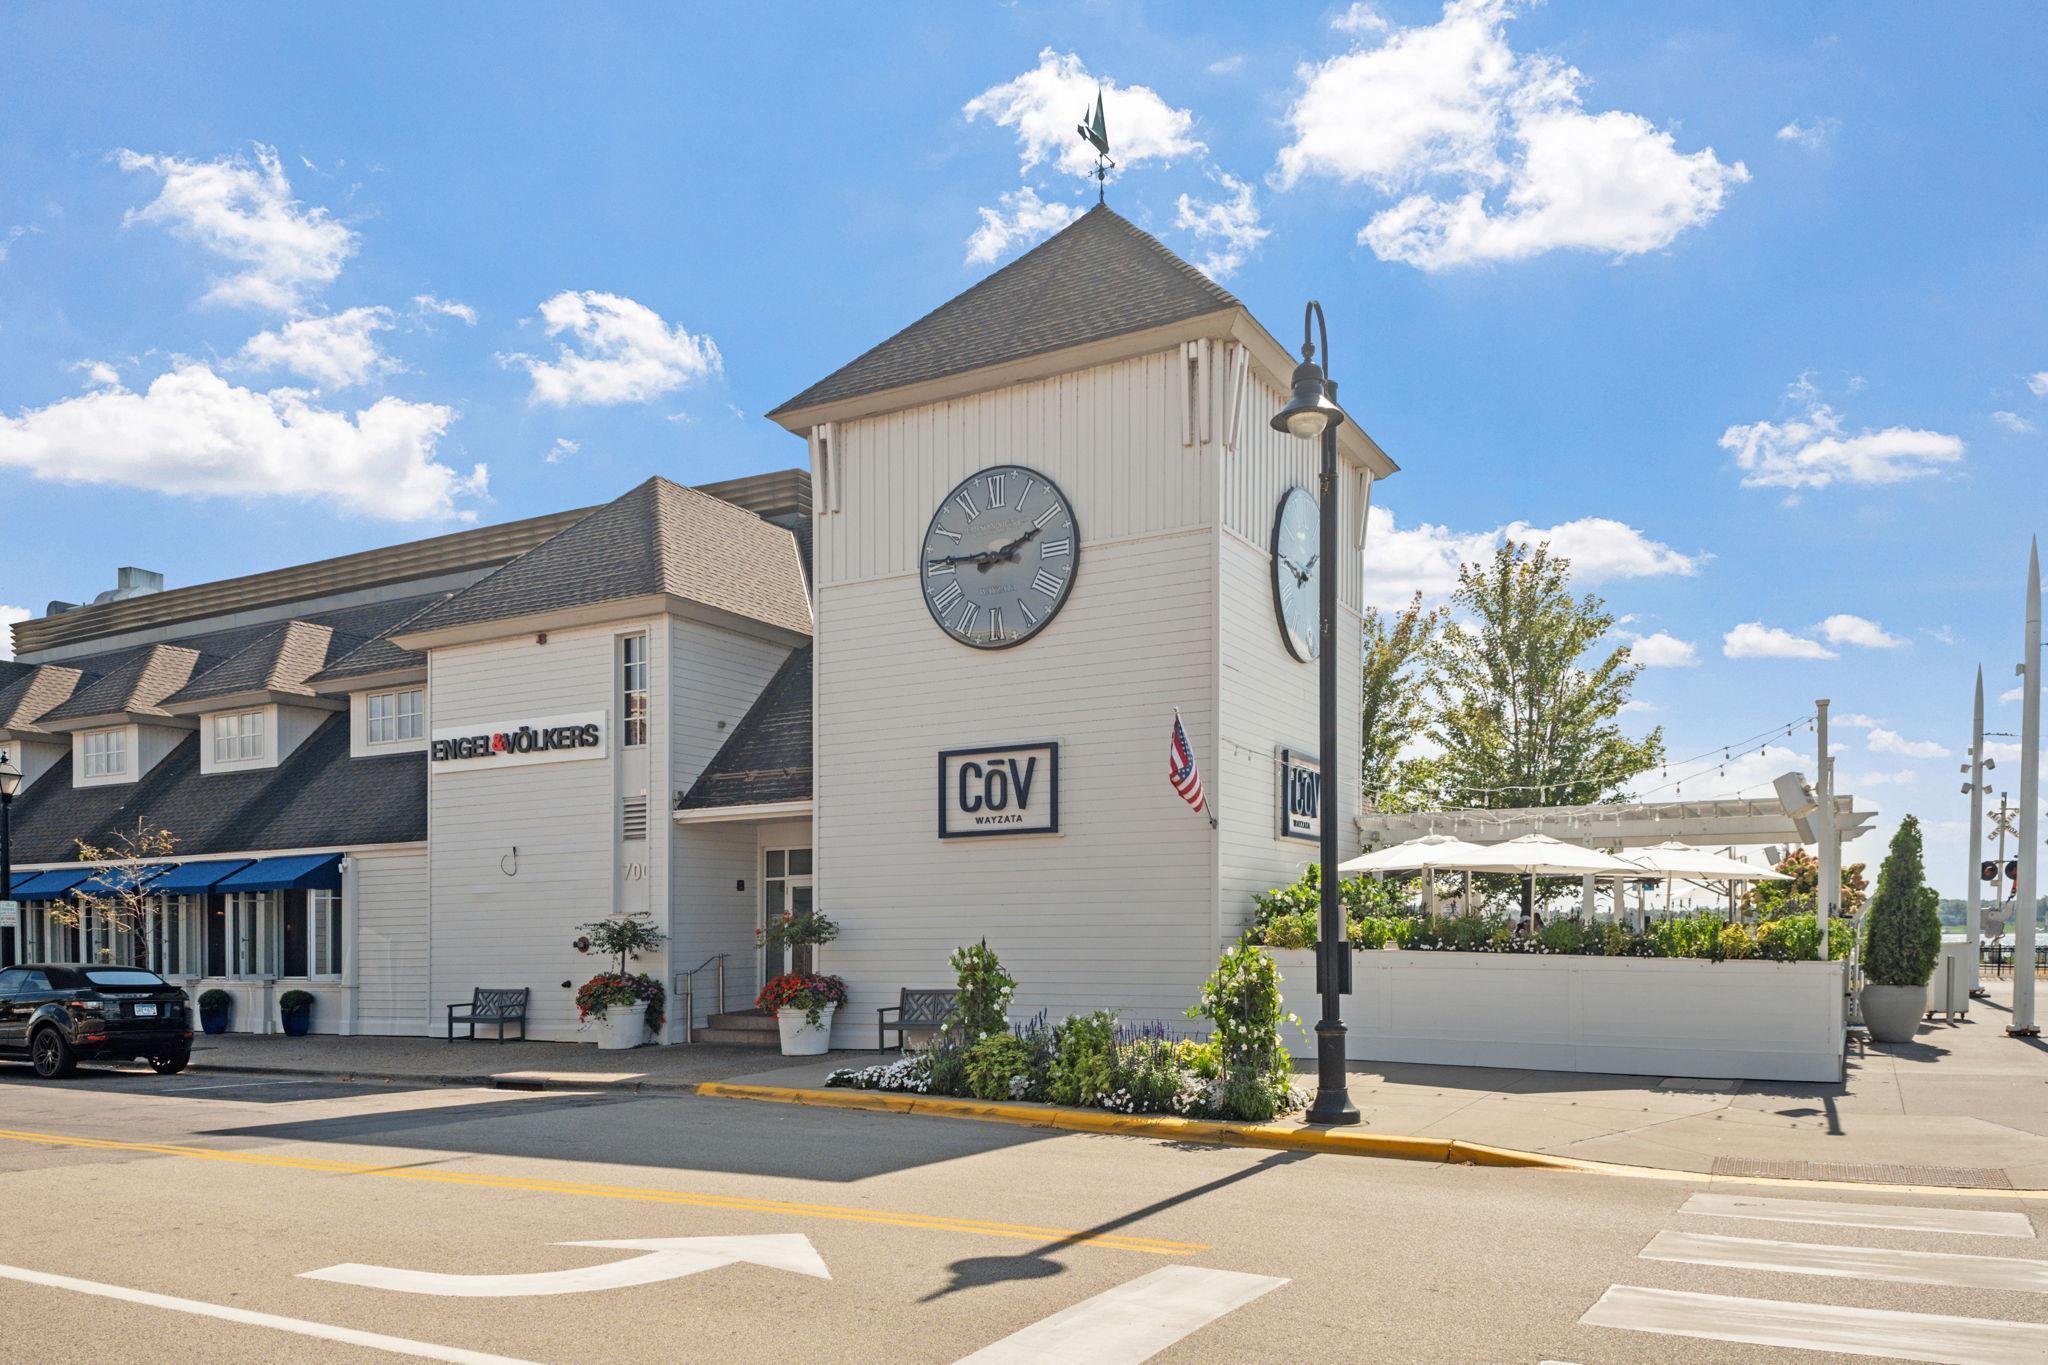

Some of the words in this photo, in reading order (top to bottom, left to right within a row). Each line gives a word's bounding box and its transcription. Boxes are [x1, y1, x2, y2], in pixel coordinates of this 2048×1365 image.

[955, 488, 980, 524] XI
[986, 474, 1006, 509] XII
[1015, 478, 1035, 512] I
[1032, 501, 1062, 529] II
[934, 524, 962, 545] X
[1040, 537, 1070, 560] III
[989, 607, 1006, 641] VI
[1018, 598, 1038, 628] V
[975, 814, 1023, 825] WAYZATA
